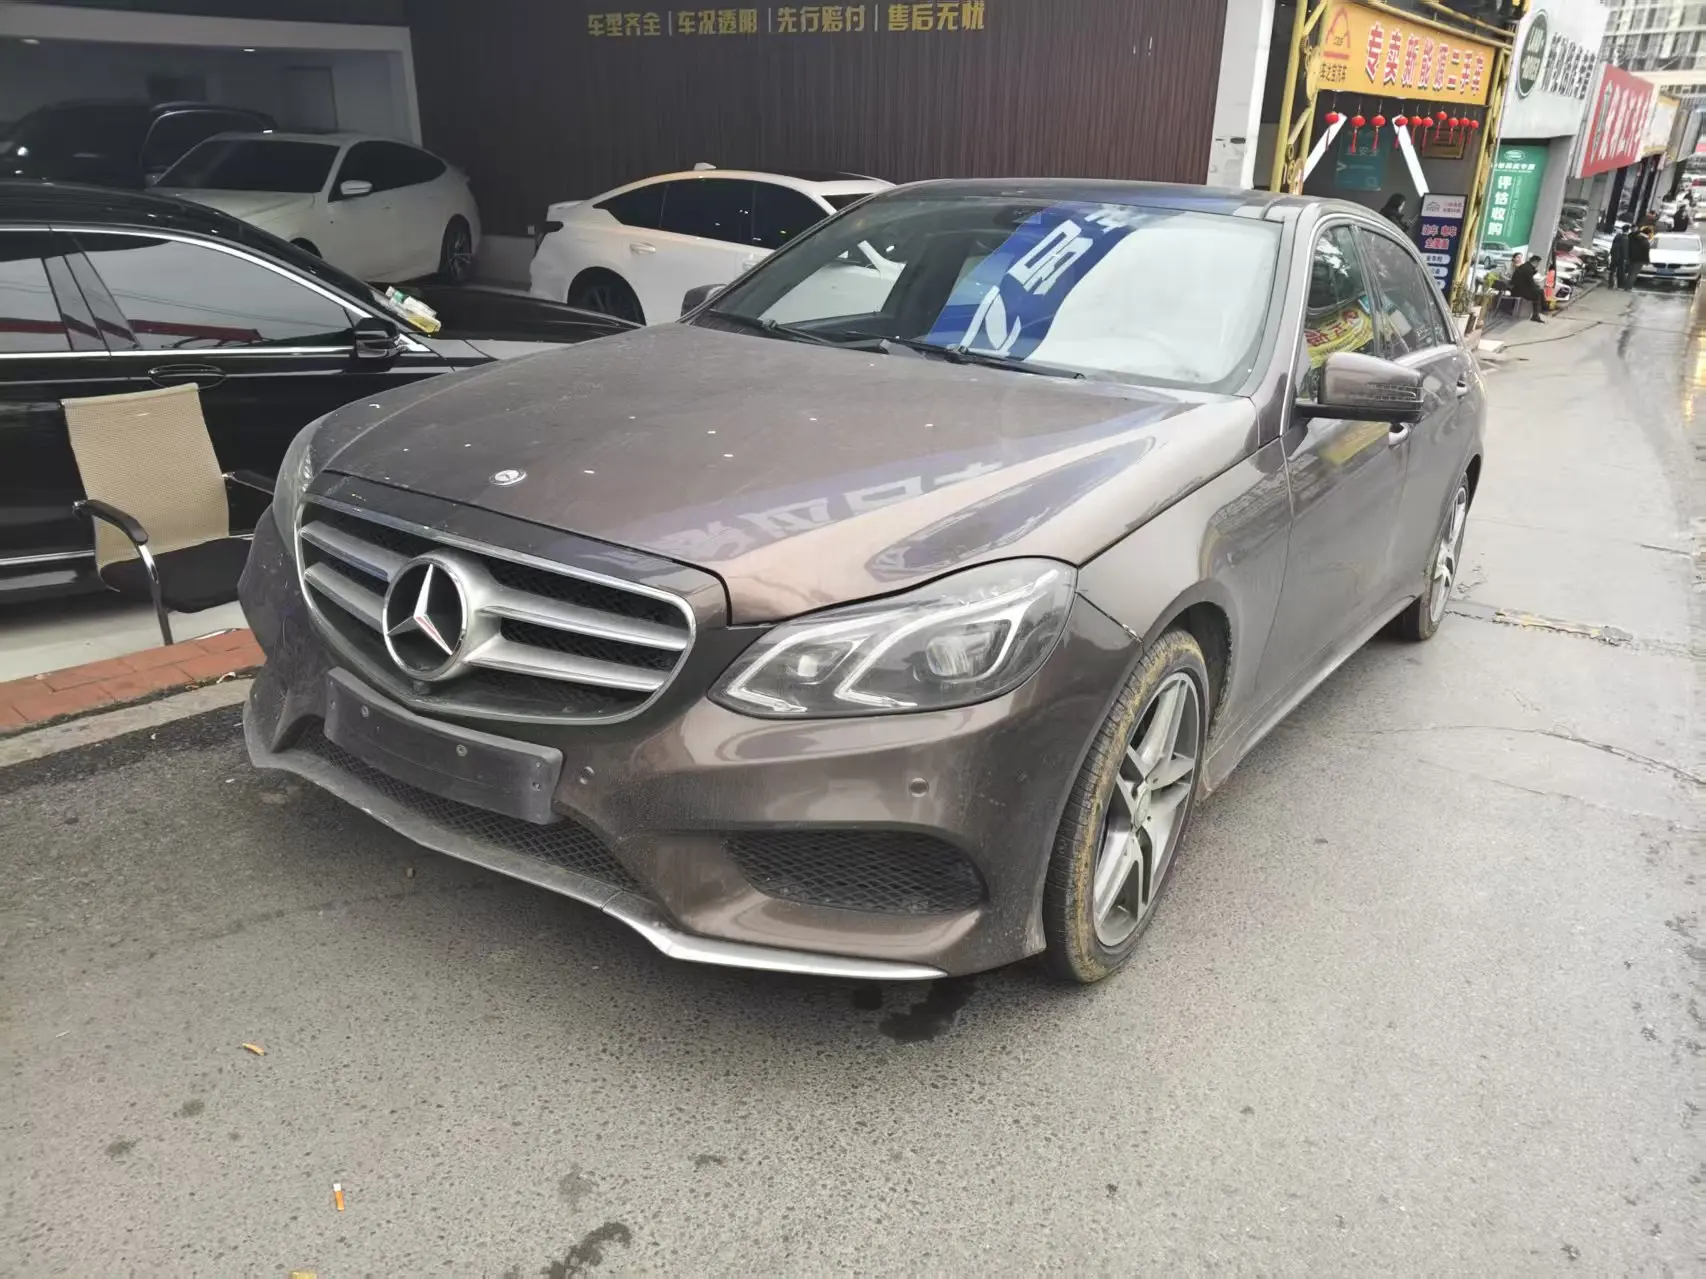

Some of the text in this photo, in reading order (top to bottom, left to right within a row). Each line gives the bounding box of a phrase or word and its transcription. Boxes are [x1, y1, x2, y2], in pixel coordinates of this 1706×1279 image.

[587, 0, 986, 37] 车型齐全 车况透明 先行赔付 售后无忧
[1487, 175, 1513, 236] 评估收购
